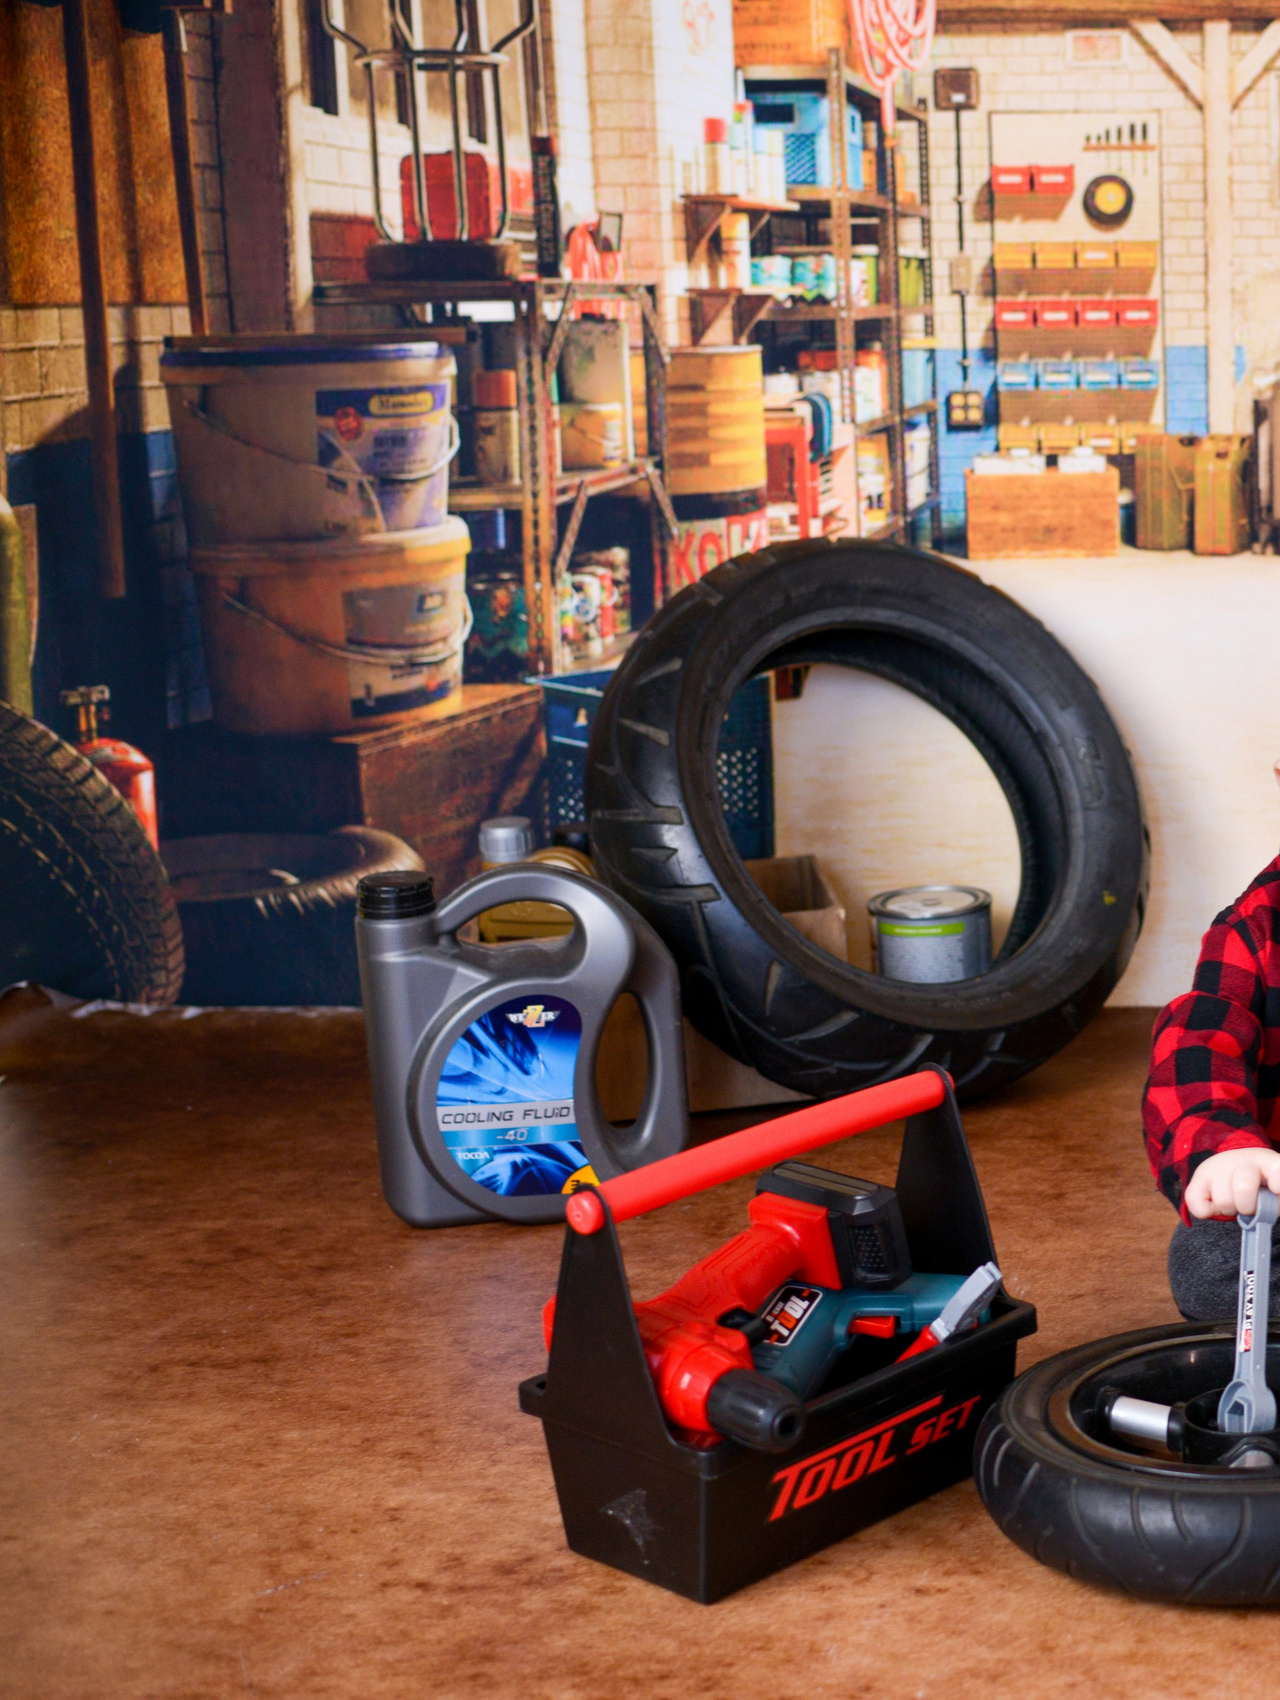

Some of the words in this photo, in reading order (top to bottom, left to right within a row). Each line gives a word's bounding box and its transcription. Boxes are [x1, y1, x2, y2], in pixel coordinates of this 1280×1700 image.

[441, 1110, 514, 1125] COOLING
[496, 1128, 528, 1142] -40
[770, 1295, 810, 1337] TOOL
[768, 1394, 943, 1523] TOOL
[906, 1395, 982, 1456] SET
